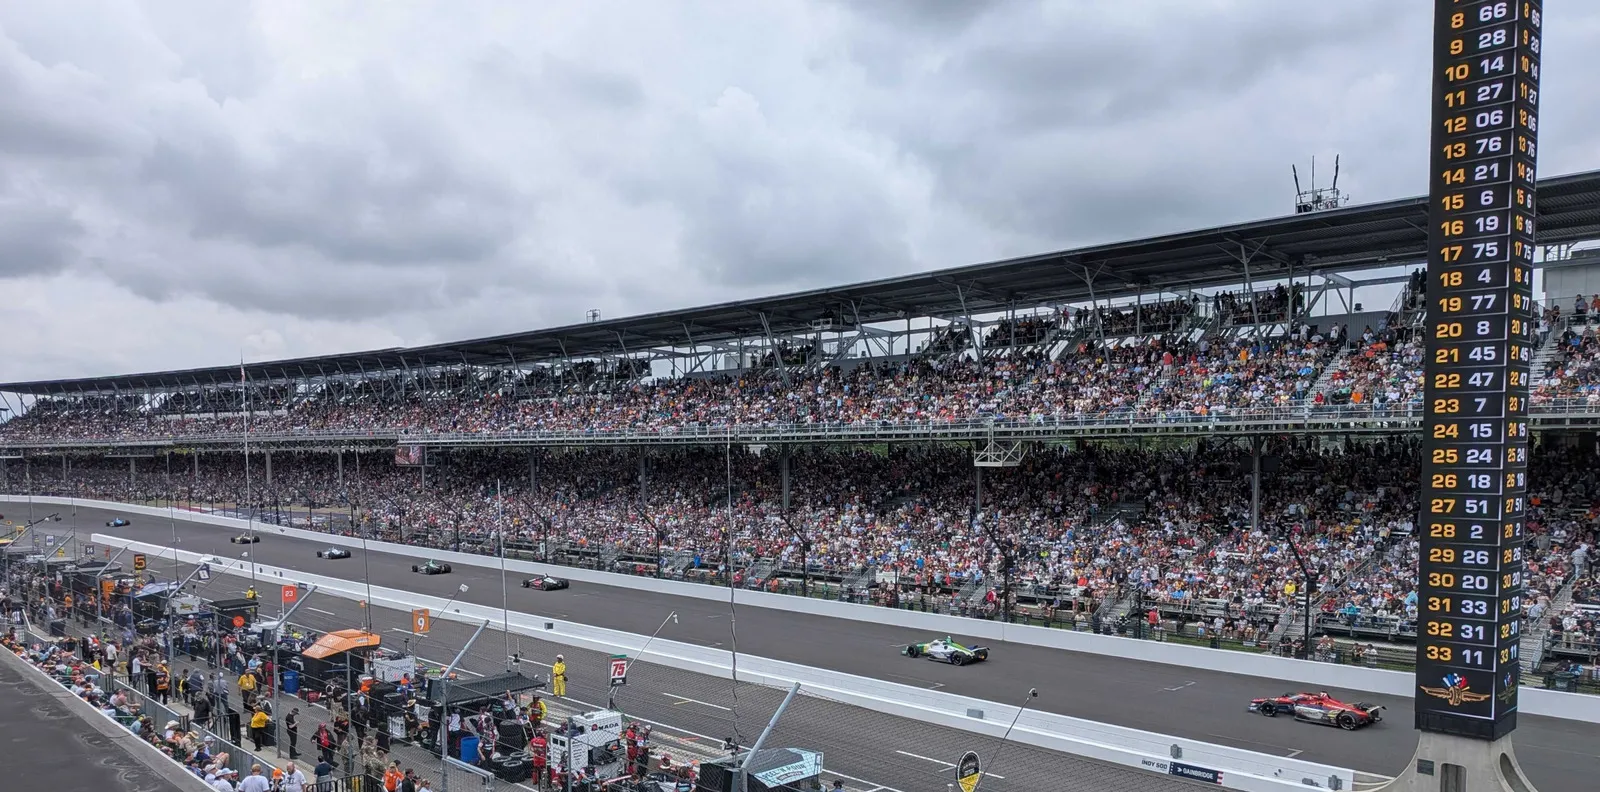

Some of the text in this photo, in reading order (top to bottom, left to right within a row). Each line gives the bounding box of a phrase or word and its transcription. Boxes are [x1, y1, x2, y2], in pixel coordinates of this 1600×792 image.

[1451, 3, 1507, 28] 8 66
[1524, 2, 1540, 28] 8 66
[1450, 29, 1506, 54] 9 28
[1523, 29, 1539, 54] 9 28
[1445, 56, 1504, 81] 10 14
[1521, 55, 1538, 80] 10 14
[1444, 83, 1503, 107] 11 27
[1520, 82, 1537, 105] 11 27
[1443, 110, 1503, 133] 12 06
[1519, 110, 1536, 131] 12 06
[1443, 137, 1501, 159] 13 76
[1518, 136, 1535, 157] 13 76
[1442, 163, 1498, 184] 14 21
[1517, 163, 1534, 183] 14 21
[1441, 191, 1493, 210] 15 6
[1516, 189, 1532, 208] 15 6
[1441, 216, 1498, 236] 16 19
[1515, 216, 1532, 234] 16 19
[1440, 242, 1497, 261] 17 75
[1514, 242, 1532, 260] 17 75
[1440, 269, 1491, 286] 18 4
[1513, 268, 1529, 285] 18 4
[1439, 294, 1496, 312] 19 77
[1513, 294, 1529, 311] 19 77
[1436, 321, 1489, 338] 20 8
[1511, 320, 1528, 336] 20 8
[1435, 346, 1495, 363] 21 45
[1510, 346, 1528, 361] 21 45
[1434, 372, 1493, 388] 22 47
[1509, 371, 1527, 386] 22 47
[1434, 398, 1486, 413] 23 7
[1509, 397, 1525, 412] 23 7
[1433, 424, 1492, 438] 24 15
[1508, 423, 1525, 436] 24 15
[1432, 449, 1492, 463] 25 24
[1507, 448, 1525, 462] 25 24
[1431, 475, 1490, 488] 26 18
[1506, 473, 1524, 487] 26 18
[1431, 499, 1487, 513] 27 51
[1505, 498, 1522, 512] 27 51
[1430, 524, 1483, 538] 28 2
[1504, 523, 1520, 538] 28 2
[135, 556, 145, 568] 5
[1429, 549, 1488, 564] 29 26
[1503, 547, 1521, 563] 29 26
[1428, 573, 1488, 589] 30 20
[1502, 572, 1520, 588] 30 20
[1428, 597, 1487, 614] 31 33
[1501, 596, 1519, 613] 31 33
[417, 617, 425, 630] 9
[1427, 622, 1483, 639] 32 31
[1500, 620, 1517, 638] 32 31
[1426, 646, 1482, 664] 33 11
[1500, 645, 1516, 662] 33 11
[612, 663, 626, 676] 75
[1155, 762, 1168, 770] 500
[1182, 767, 1214, 780] GAINBRIDGE
